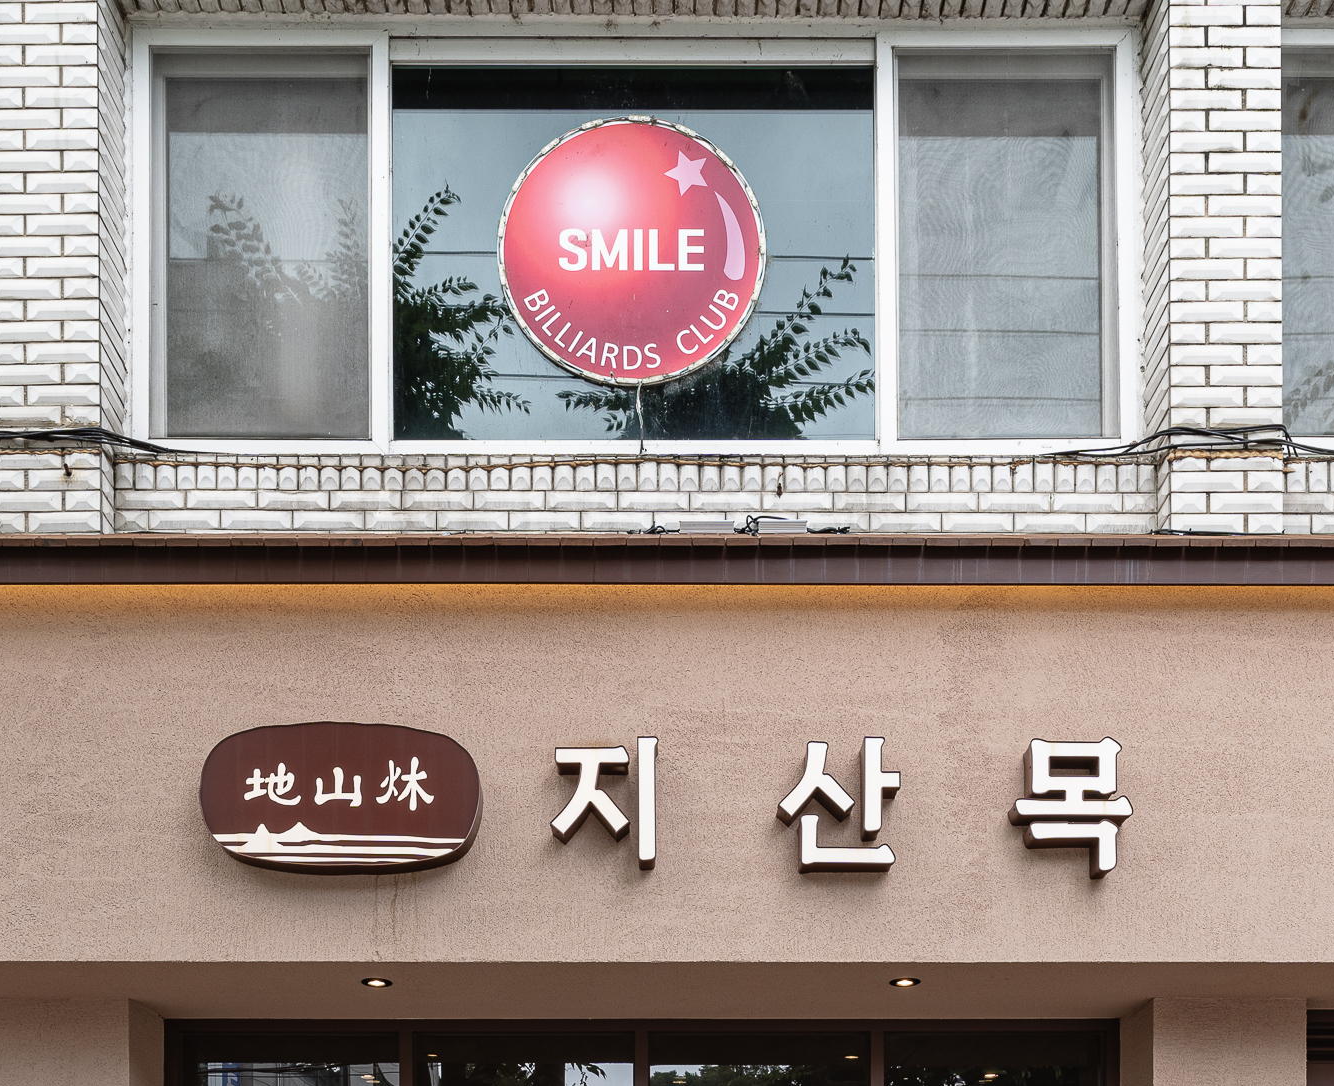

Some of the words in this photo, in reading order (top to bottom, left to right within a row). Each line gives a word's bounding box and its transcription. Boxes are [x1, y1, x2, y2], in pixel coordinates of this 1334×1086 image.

[558, 228, 705, 272] SMILE
[523, 288, 662, 371] BILLIARDS
[676, 287, 739, 356] CLUB
